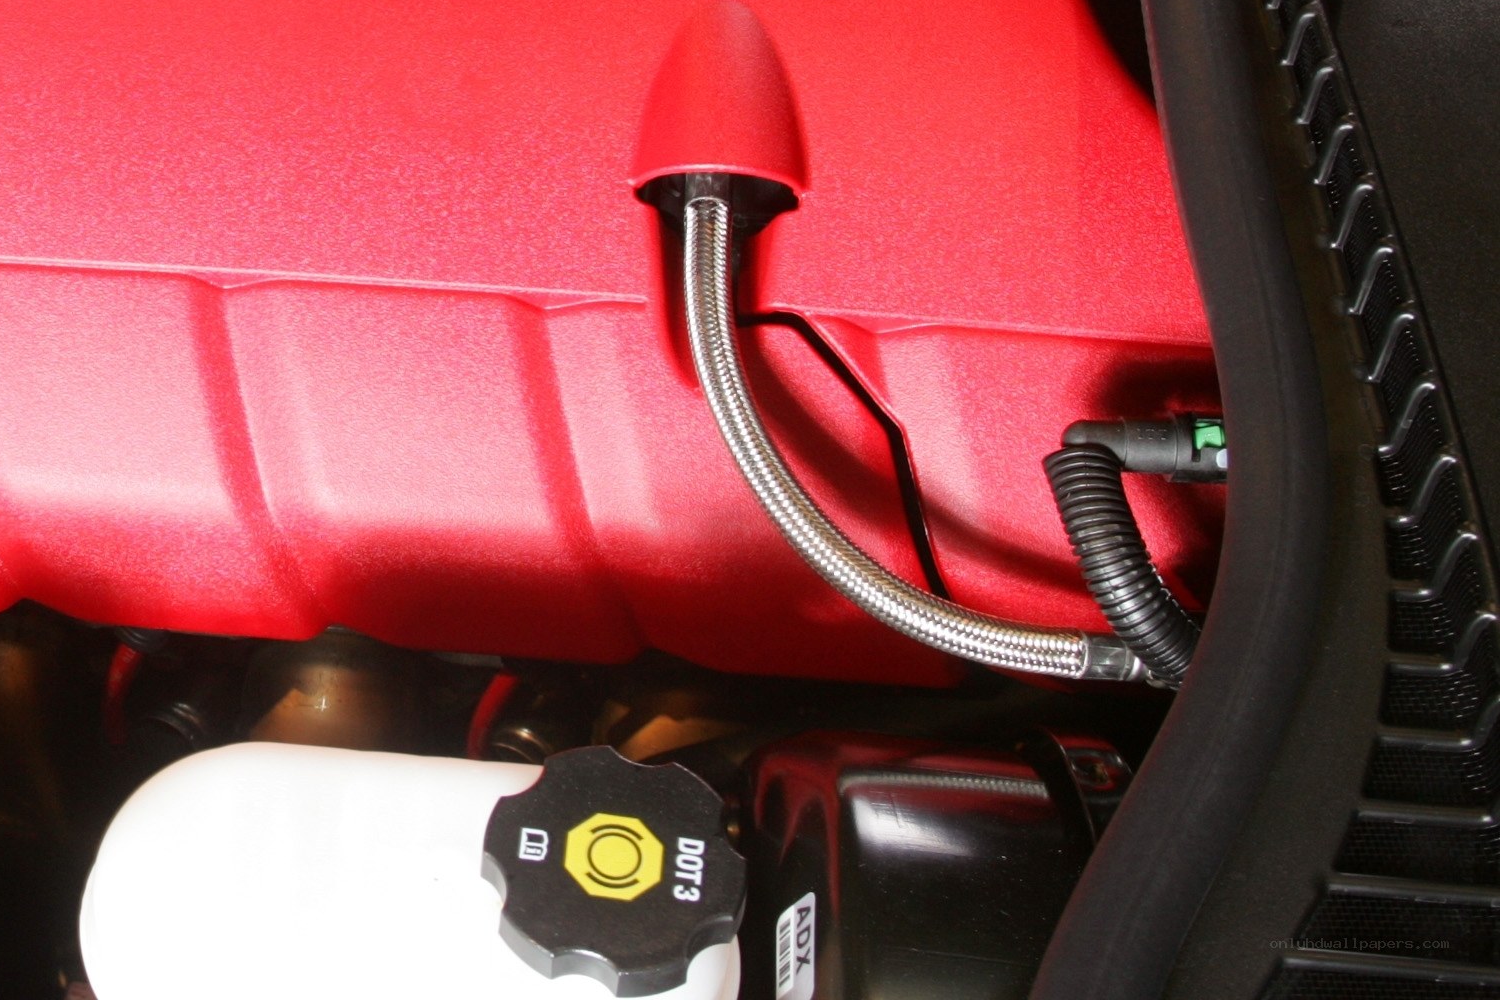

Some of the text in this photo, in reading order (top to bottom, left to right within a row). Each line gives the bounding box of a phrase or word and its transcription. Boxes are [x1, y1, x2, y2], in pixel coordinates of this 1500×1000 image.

[673, 837, 705, 902] DOT 3
[796, 906, 811, 975] ADX
